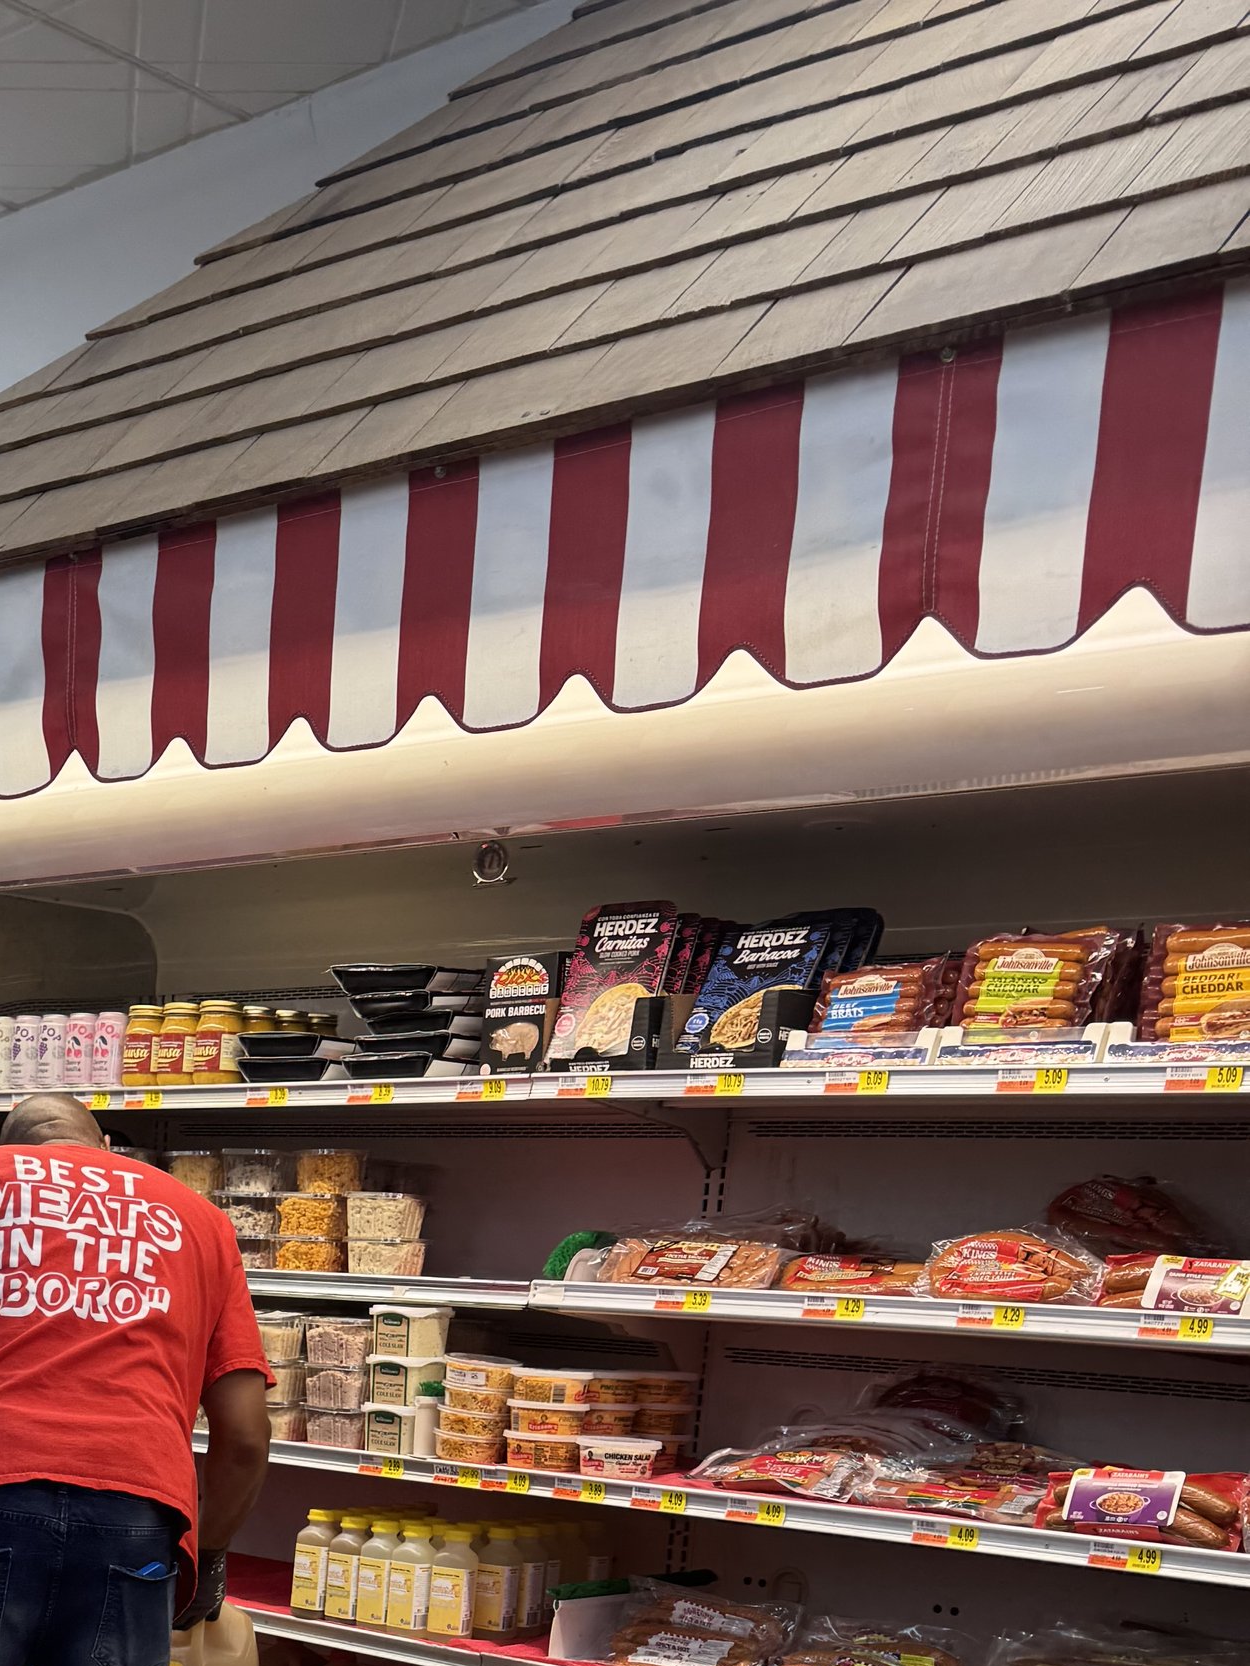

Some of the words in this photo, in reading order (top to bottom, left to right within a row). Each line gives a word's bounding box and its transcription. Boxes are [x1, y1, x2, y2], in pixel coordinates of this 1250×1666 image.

[594, 918, 658, 937] HERDEZ
[595, 936, 650, 953] Carnitas
[737, 930, 806, 949] HERDEZ
[733, 948, 801, 964] Barbacoa
[1189, 950, 1250, 970] Johnsonville
[997, 957, 1053, 971] Johnsonville
[840, 982, 893, 996] Johnsonville
[985, 983, 1040, 994] CHEDDAR
[1182, 981, 1244, 995] CHEDDAR
[485, 1007, 506, 1019] PORK
[508, 1004, 546, 1017] BARBECU
[831, 1008, 864, 1019] BRATS
[690, 1057, 736, 1069] HERDEZ
[723, 1075, 742, 1088] 10.79
[866, 1071, 883, 1086] 6.09
[1044, 1069, 1063, 1084] 5.09
[1217, 1067, 1237, 1084] 5.09
[488, 1080, 502, 1093] 9.09
[591, 1078, 609, 1091] 10.79
[14, 1154, 144, 1196] BEST
[66, 1230, 160, 1284] THE
[962, 1248, 998, 1260] KINGS
[692, 1293, 707, 1307] 5.39
[844, 1299, 860, 1313] 4.29
[1002, 1308, 1021, 1323] 4.29
[1188, 1318, 1209, 1334] 4.99
[604, 1453, 633, 1461] CHICKEN
[634, 1454, 651, 1462] SALAD
[513, 1475, 527, 1488] 4.09
[589, 1483, 603, 1496] 3.89
[668, 1493, 683, 1507] 4.09
[766, 1505, 781, 1518] 4.09
[957, 1528, 975, 1543] 4.09
[1138, 1549, 1157, 1564] 4.99
